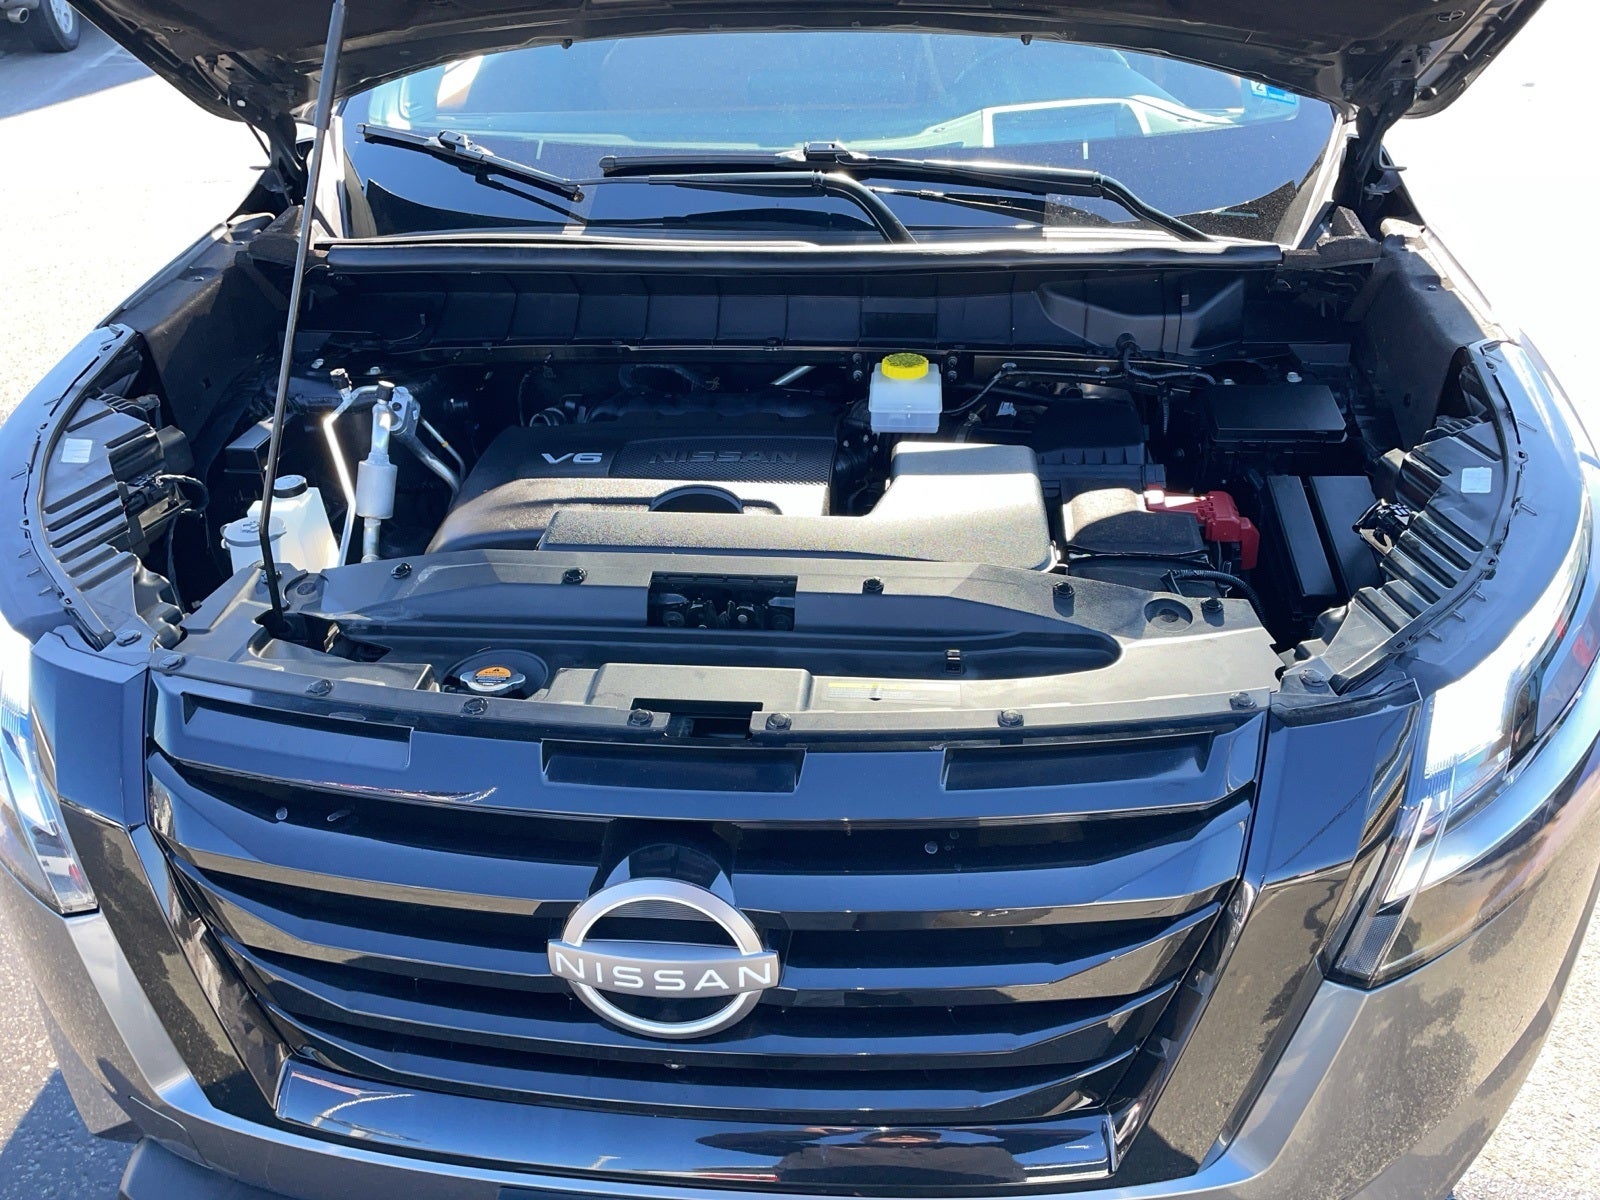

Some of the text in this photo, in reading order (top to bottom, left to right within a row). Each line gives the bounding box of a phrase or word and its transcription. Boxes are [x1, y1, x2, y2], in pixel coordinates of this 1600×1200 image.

[541, 452, 603, 465] V6
[649, 451, 800, 464] NISSAN
[555, 951, 771, 991] NISSAN
